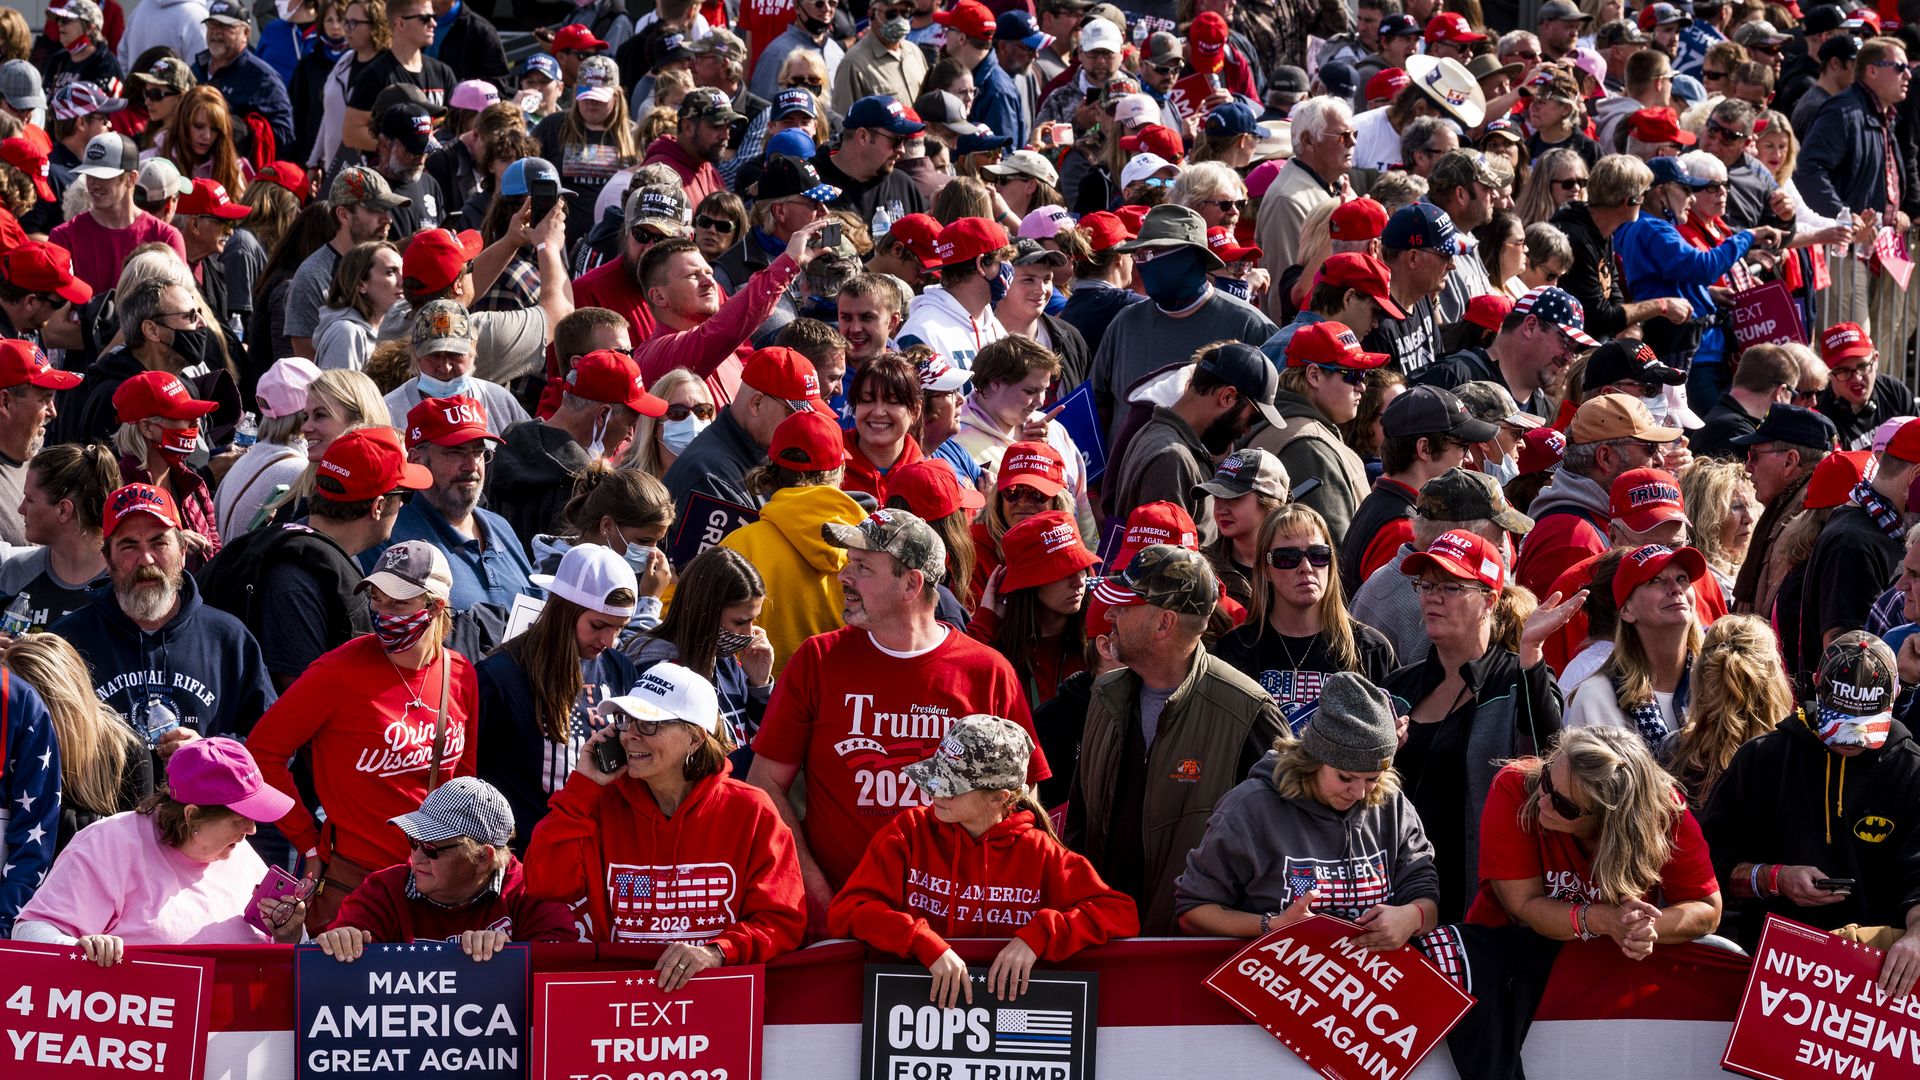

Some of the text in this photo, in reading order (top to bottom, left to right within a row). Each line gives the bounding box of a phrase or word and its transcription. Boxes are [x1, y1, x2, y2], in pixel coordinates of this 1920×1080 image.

[779, 91, 809, 101] TRUMP
[644, 194, 678, 206] TRUMP
[1409, 234, 1423, 246] 45
[443, 404, 484, 425] USA
[411, 427, 422, 440] 45
[320, 460, 351, 478] TRUMP2020
[1008, 462, 1049, 473] GREAT AGAIN
[1025, 455, 1054, 466] AMERICA
[112, 487, 165, 513] TRUMP
[1628, 485, 1679, 504] TRUMP
[1041, 526, 1074, 542] Trump
[1140, 527, 1170, 538] AMERICA
[97, 671, 216, 708] NATIONAL RIFLE
[1831, 679, 1885, 702] TRUMP
[184, 713, 199, 721] 1871
[845, 693, 964, 742] Trump
[910, 702, 949, 719] President
[616, 872, 729, 914] TRUMP
[908, 867, 1041, 905] MAKE AMERICA
[908, 891, 1036, 927] GREAT AGAIN
[650, 915, 691, 932] 2020
[1330, 935, 1404, 991] MAKE
[1764, 947, 1855, 995] AGAIN
[369, 970, 458, 996] MAKE
[5, 984, 176, 1029] 4 MORE
[1259, 937, 1419, 1060] AMERICA
[308, 1003, 518, 1038] AMERICA
[608, 1000, 694, 1028] TEXT
[1237, 958, 1398, 1080] GREAT AGAIN
[887, 1003, 991, 1053] COPS
[6, 1028, 168, 1073] YEARS!
[308, 1048, 518, 1073] GREAT AGAIN
[591, 1034, 710, 1064] TRUMP
[1795, 1038, 1875, 1080] MAKE
[894, 1060, 935, 1080] FOR
